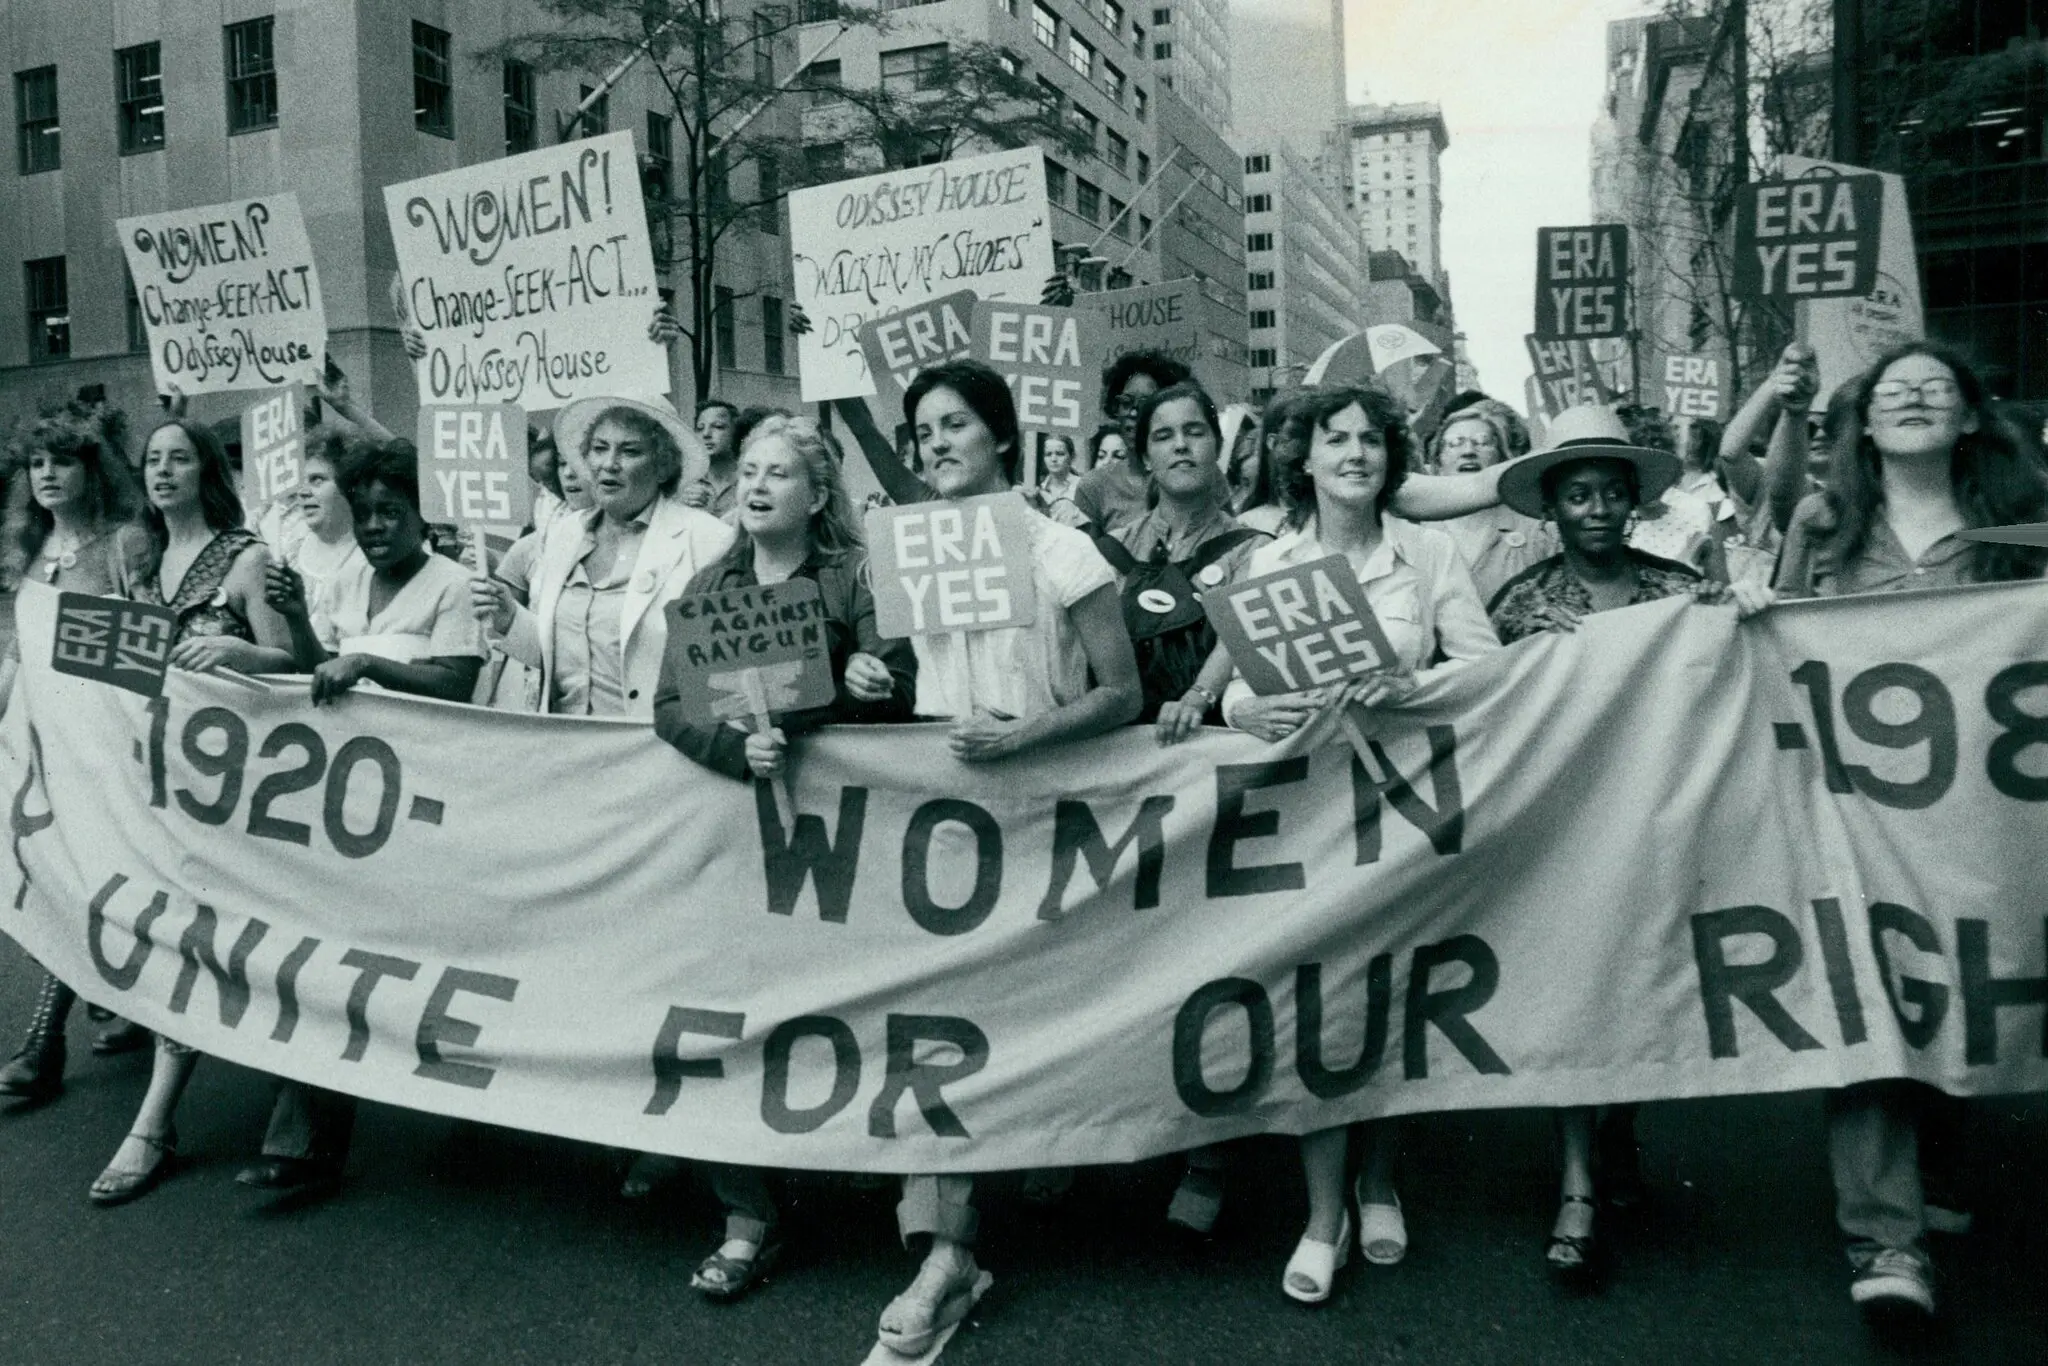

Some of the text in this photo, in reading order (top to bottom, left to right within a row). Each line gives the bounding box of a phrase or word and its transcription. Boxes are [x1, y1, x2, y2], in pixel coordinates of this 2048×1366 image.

[405, 148, 613, 266] WOMEN!
[929, 166, 1031, 213] HOUSE
[1755, 181, 1857, 238] ERA
[134, 202, 270, 284] WOMEN!
[1550, 231, 1615, 281] ERA
[1756, 240, 1858, 296] YES
[876, 302, 972, 370] ERA
[989, 310, 1082, 368] ERA
[1109, 293, 1185, 330] HOUSE
[1552, 285, 1616, 335] YES
[230, 328, 313, 384] House
[429, 328, 613, 403] Odyssey House
[1664, 355, 1719, 387] ERA
[251, 390, 298, 451] ERA
[1664, 385, 1720, 417] YES
[433, 409, 509, 460] ERA
[255, 438, 300, 501] YES
[434, 469, 512, 520] YES
[892, 504, 1004, 571] ERA
[710, 598, 823, 635] AGAINST
[898, 565, 1012, 631] YES
[1227, 569, 1356, 642] ERA
[56, 607, 114, 667] ERA
[112, 610, 173, 677] YES
[686, 623, 820, 667] RAYGUN
[1256, 619, 1384, 690] YES
[753, 723, 1465, 937] WOMEN
[87, 872, 521, 1090] UNITE
[642, 1004, 990, 1139] FOR
[1172, 933, 1512, 1119] OUR
